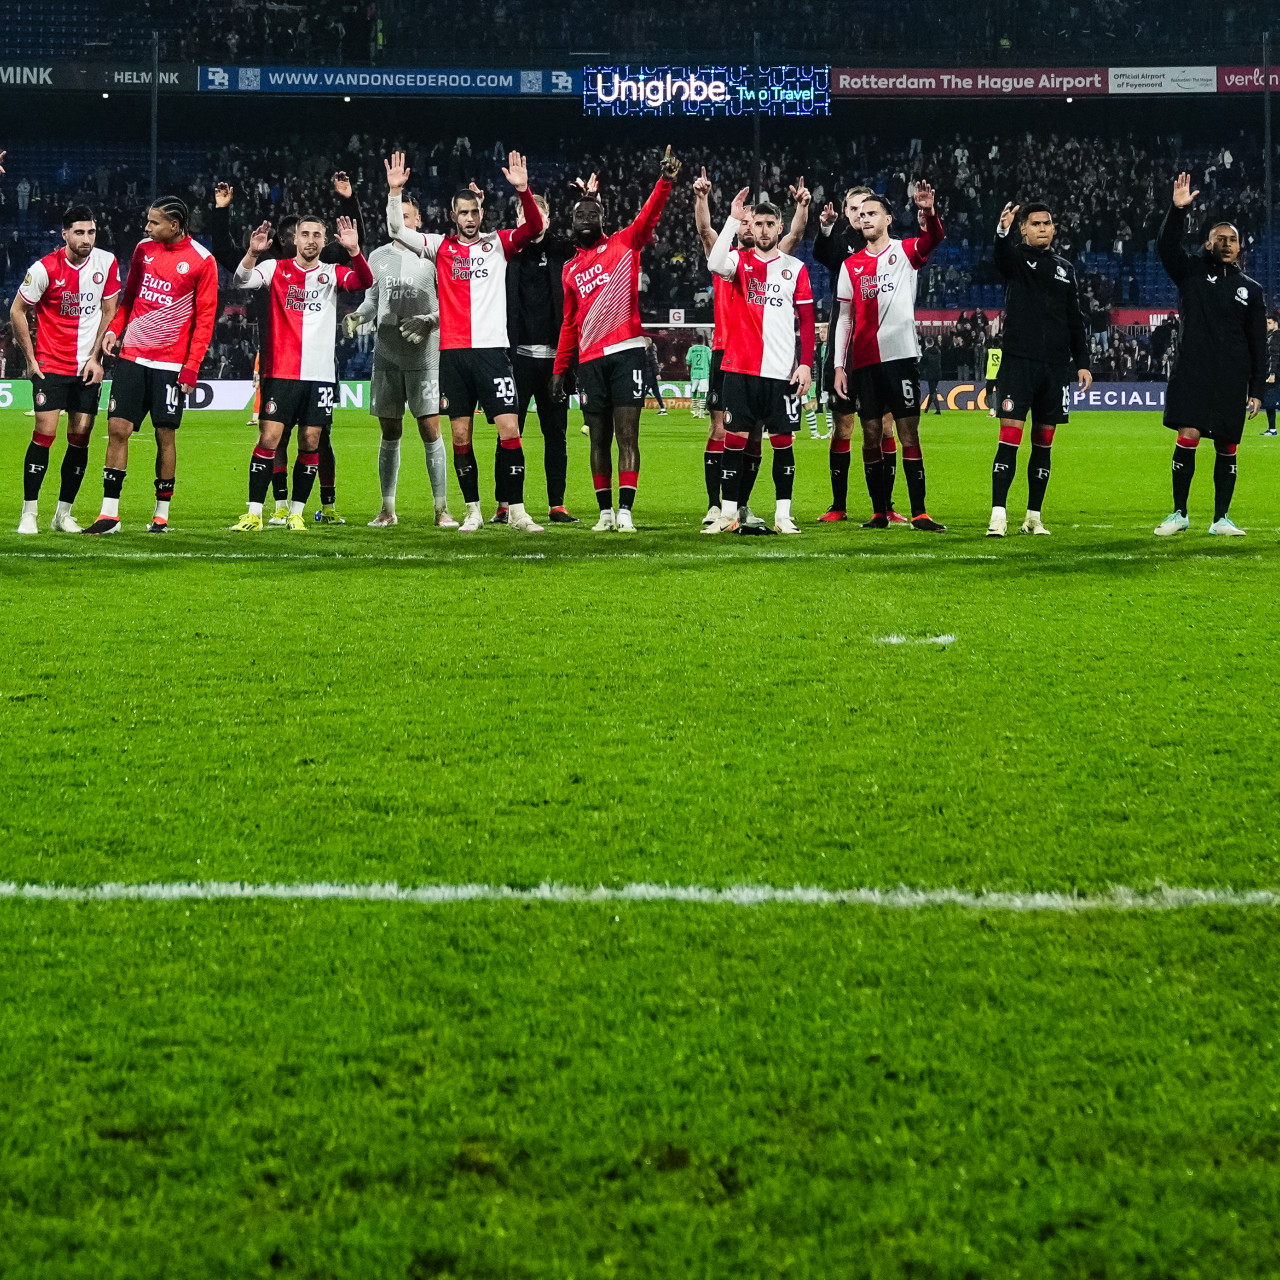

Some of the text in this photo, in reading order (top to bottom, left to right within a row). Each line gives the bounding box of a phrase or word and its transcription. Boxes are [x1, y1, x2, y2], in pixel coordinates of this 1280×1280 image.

[114, 71, 179, 85] HELMNK
[268, 71, 513, 88] WWW.VANDONGEDEROO.COM
[839, 72, 1101, 92] Rotterdam The Hague Airport
[1142, 72, 1165, 80] Airport
[1126, 81, 1162, 90] Feyenoord
[771, 86, 814, 100] Travel
[452, 256, 484, 268] Euro
[452, 268, 489, 280] Parcs
[574, 264, 603, 287] Euro
[142, 272, 172, 291] Euro
[385, 276, 414, 287] Euro
[578, 272, 610, 299] Parcs
[748, 278, 781, 292] Euro
[61, 291, 94, 304] Euro
[139, 287, 173, 306] Parcs
[287, 285, 319, 300] Euro
[386, 288, 418, 300] Parcs
[862, 282, 895, 300] Parcs
[285, 298, 322, 312] Parcs
[747, 292, 783, 307] Parcs
[60, 303, 96, 316] Parcs
[673, 312, 681, 321] G
[695, 354, 702, 366] 2
[632, 370, 643, 390] 4
[493, 377, 515, 398] 33
[901, 379, 914, 399] 6
[165, 383, 178, 407] 10
[318, 387, 334, 407] 32
